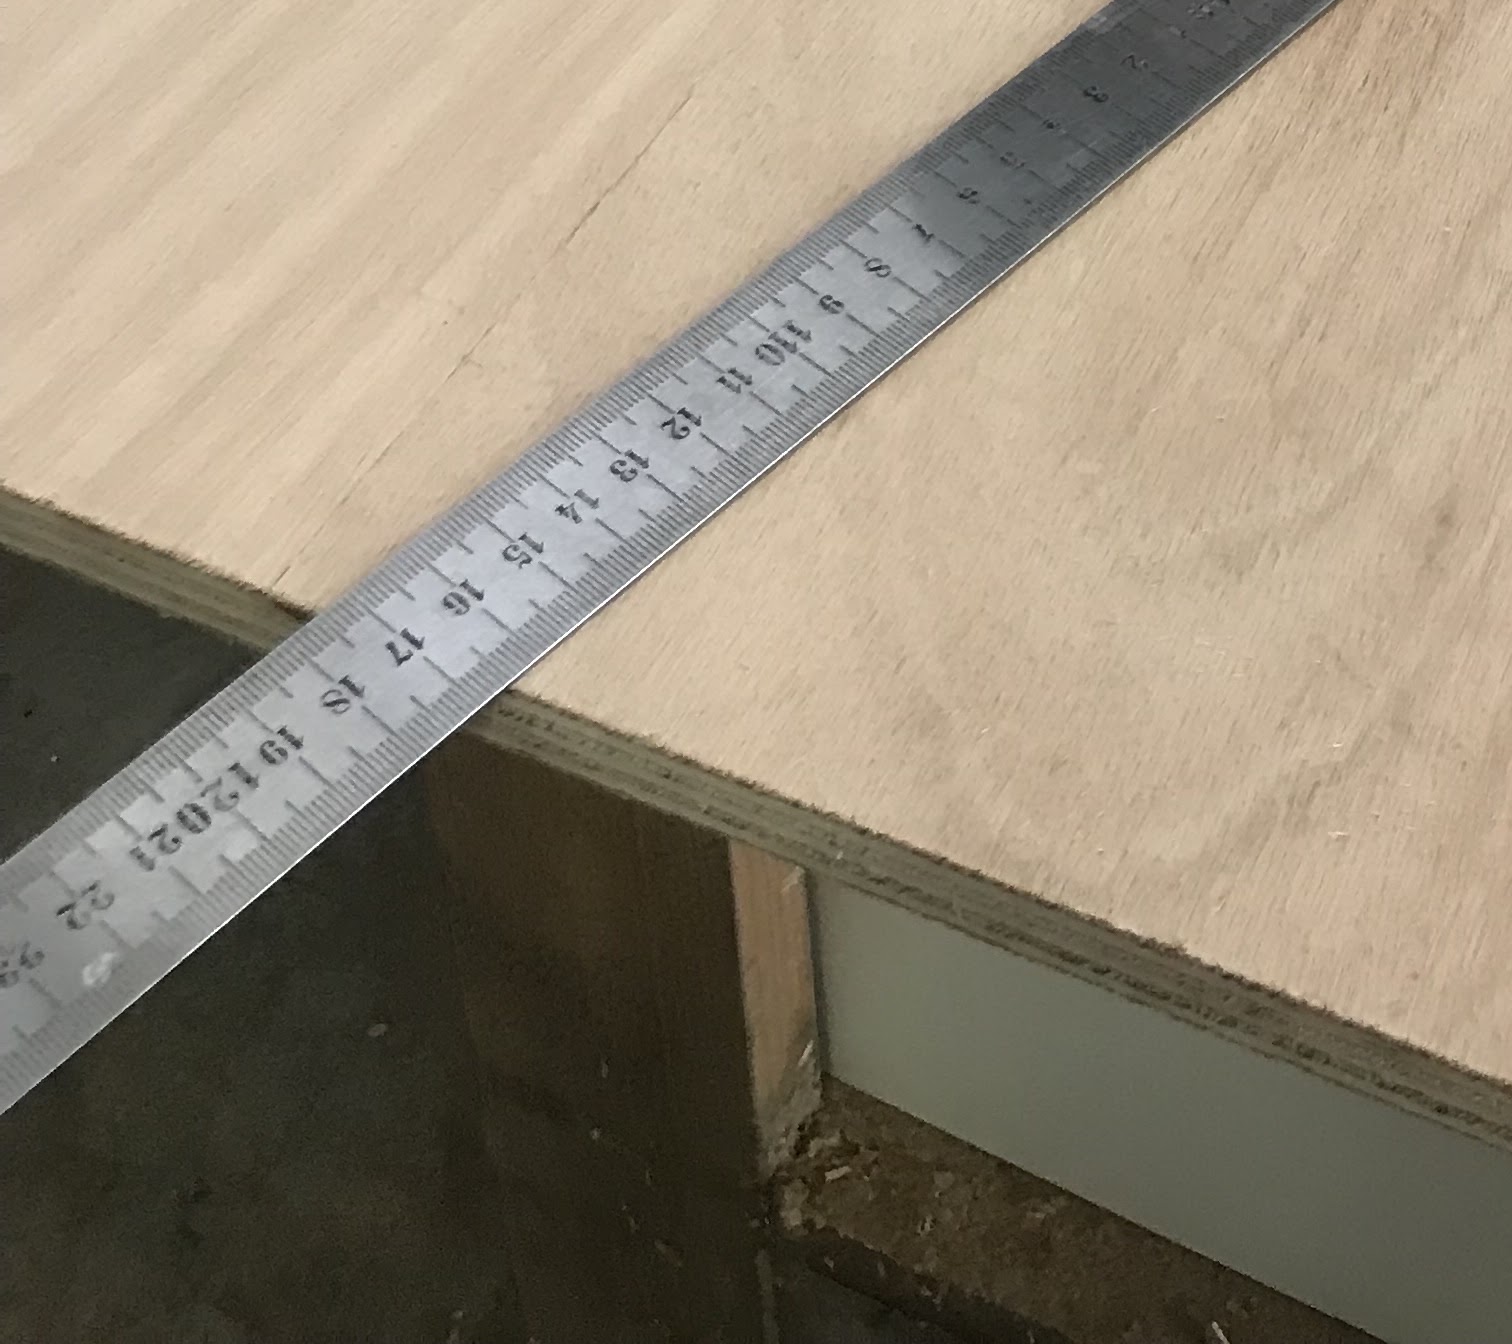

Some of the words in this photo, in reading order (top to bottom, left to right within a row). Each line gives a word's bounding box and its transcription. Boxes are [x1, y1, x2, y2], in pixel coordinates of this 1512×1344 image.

[861, 255, 892, 279] 8
[815, 293, 846, 317] 9
[714, 364, 756, 397] 11
[657, 404, 706, 443] 12
[605, 446, 653, 484] 13
[553, 487, 603, 526] 14
[498, 531, 548, 570] 15
[437, 577, 488, 618] 16
[380, 626, 429, 664] 17
[315, 673, 369, 717] 18
[255, 724, 308, 767] 19
[126, 824, 185, 872] 21
[53, 881, 118, 933] 22
